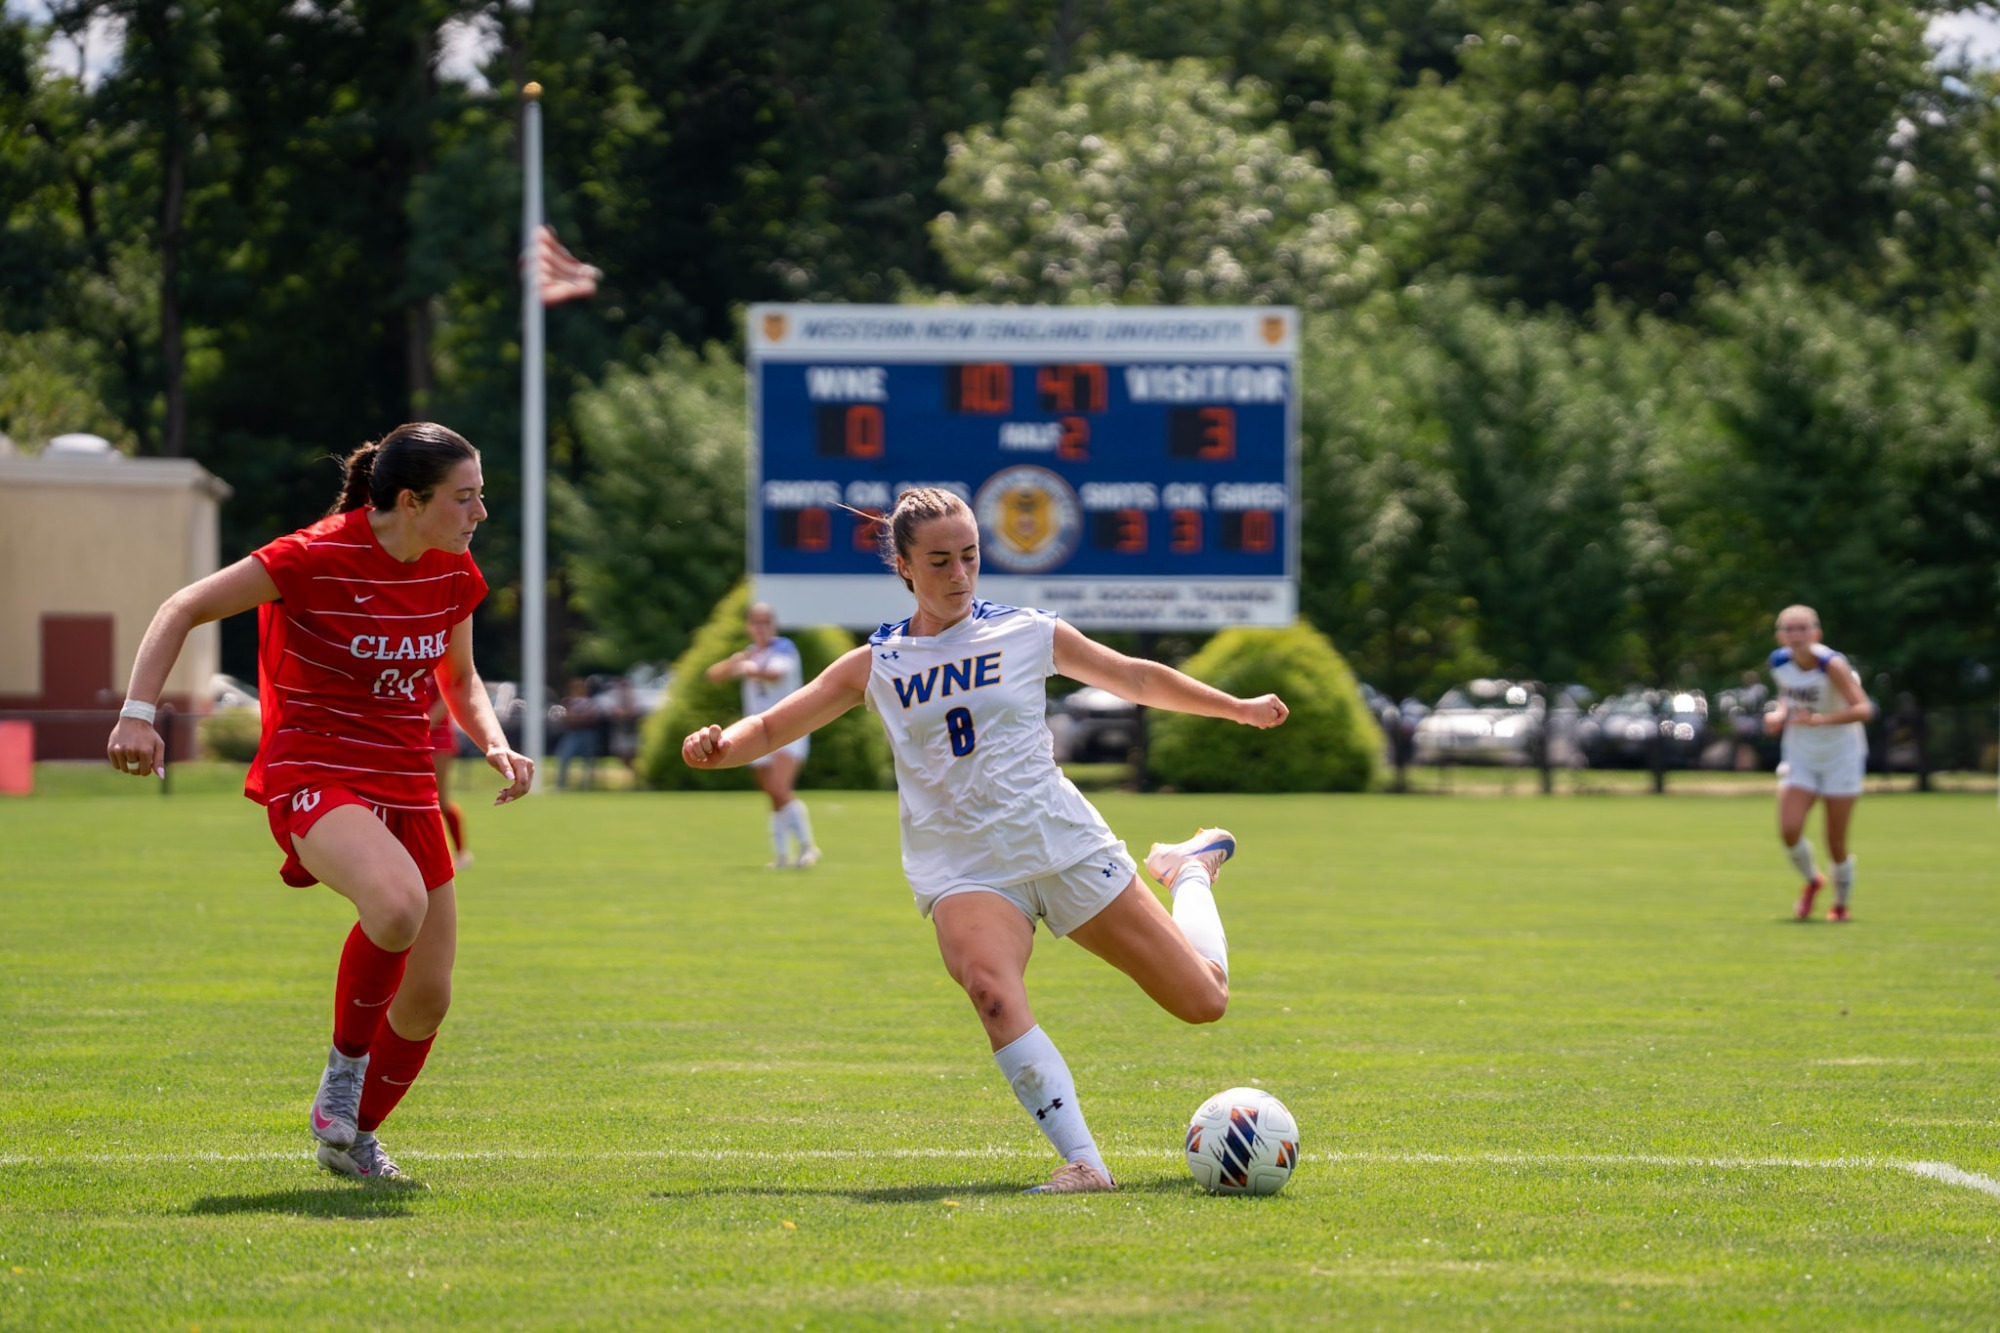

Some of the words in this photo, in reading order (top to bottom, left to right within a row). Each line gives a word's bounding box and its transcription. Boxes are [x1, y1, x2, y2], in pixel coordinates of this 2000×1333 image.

[806, 367, 888, 401] WNE
[961, 362, 1012, 415] 10
[1037, 362, 1108, 414] 47
[1125, 366, 1288, 402] VISITOR
[845, 404, 885, 459] 0
[1056, 416, 1091, 461] 2
[1198, 406, 1237, 460] 3
[1115, 508, 1148, 554] 3
[1170, 508, 1203, 554] 3
[349, 629, 447, 660] CLARK
[891, 650, 1003, 710] WNE
[945, 705, 977, 758] 8
